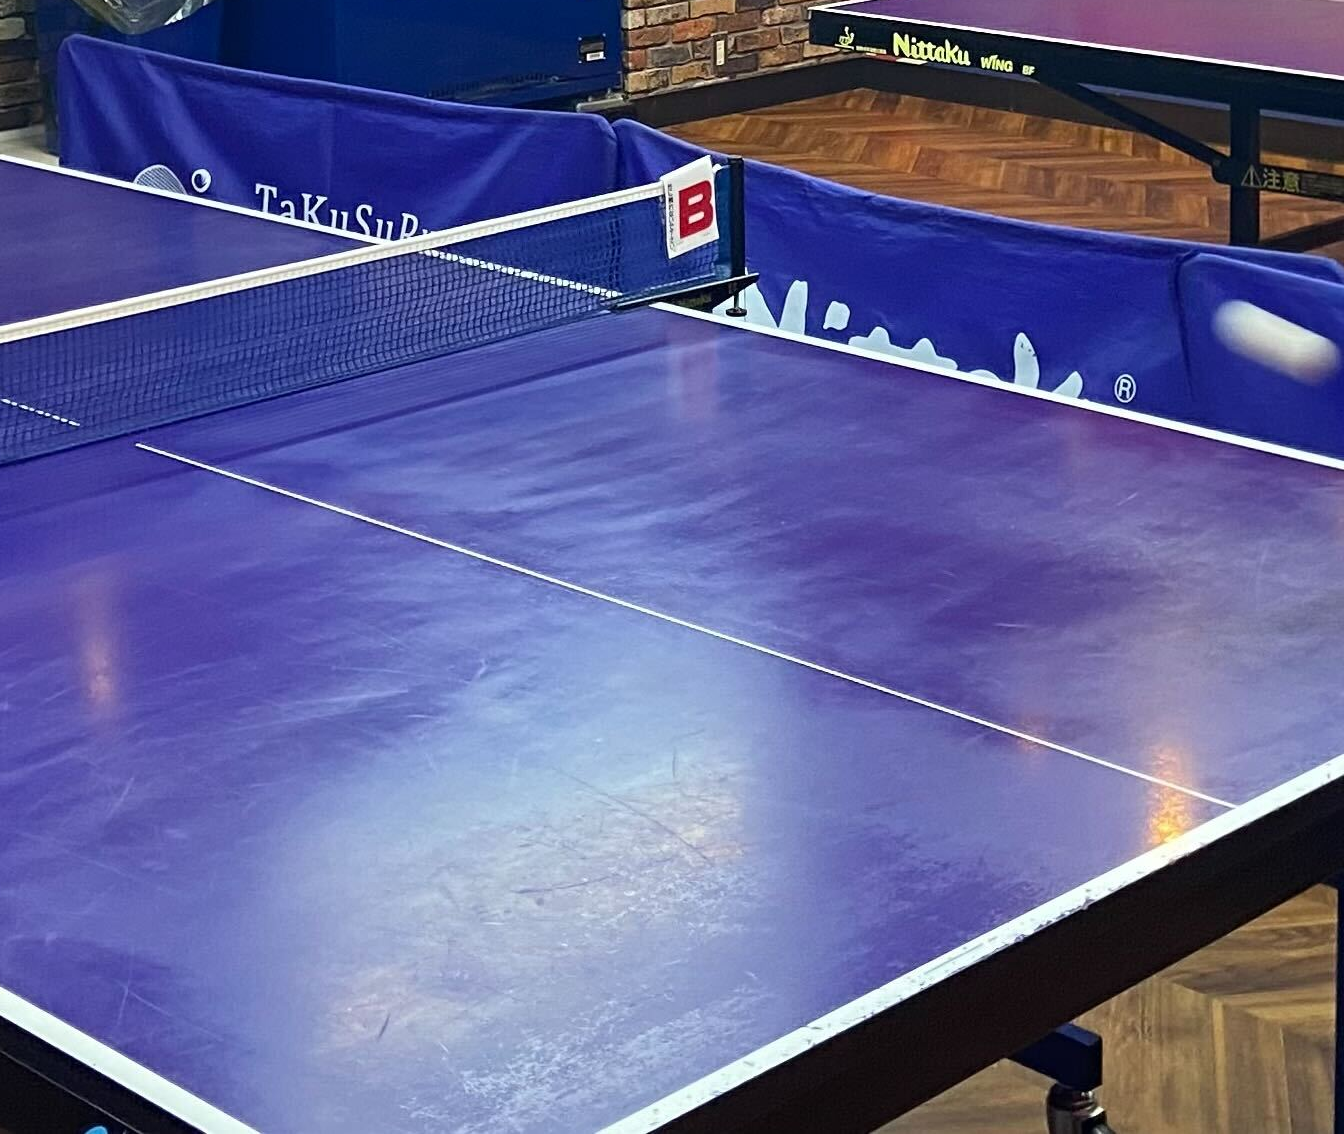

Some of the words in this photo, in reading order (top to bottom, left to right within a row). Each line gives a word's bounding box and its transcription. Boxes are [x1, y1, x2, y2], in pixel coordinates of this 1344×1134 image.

[892, 32, 971, 66] Nittaku
[1263, 168, 1300, 194] 注意
[678, 180, 714, 240] B
